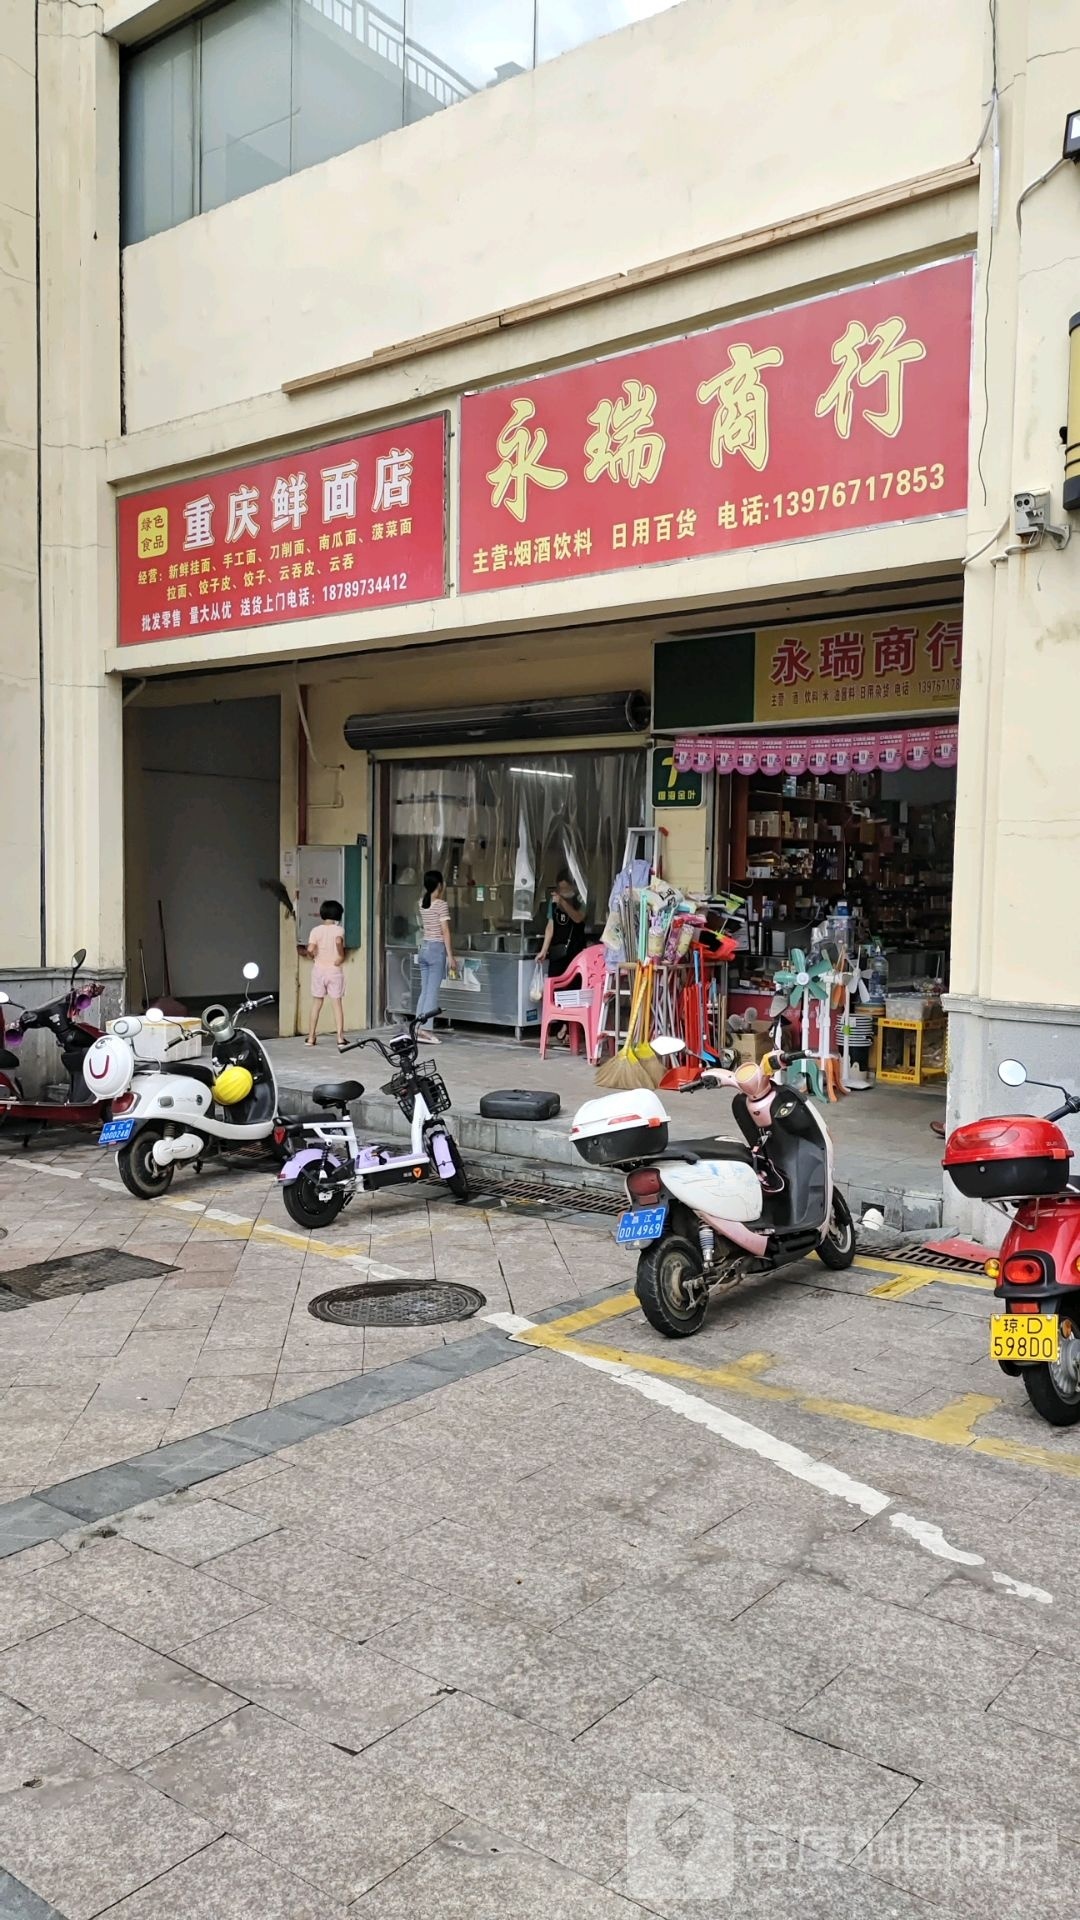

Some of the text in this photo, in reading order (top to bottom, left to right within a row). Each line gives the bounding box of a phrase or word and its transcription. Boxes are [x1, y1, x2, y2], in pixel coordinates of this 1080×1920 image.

[487, 315, 927, 522] 永瑞商行
[183, 448, 414, 551] 重庆鲜面店
[140, 513, 165, 531] 绿色
[612, 508, 697, 550] 日用百货
[140, 535, 164, 552] 食品
[141, 608, 182, 632] 批发零售
[189, 601, 232, 625] 量大从优
[770, 620, 963, 686] 永瑞商行
[893, 680, 910, 697] 电话
